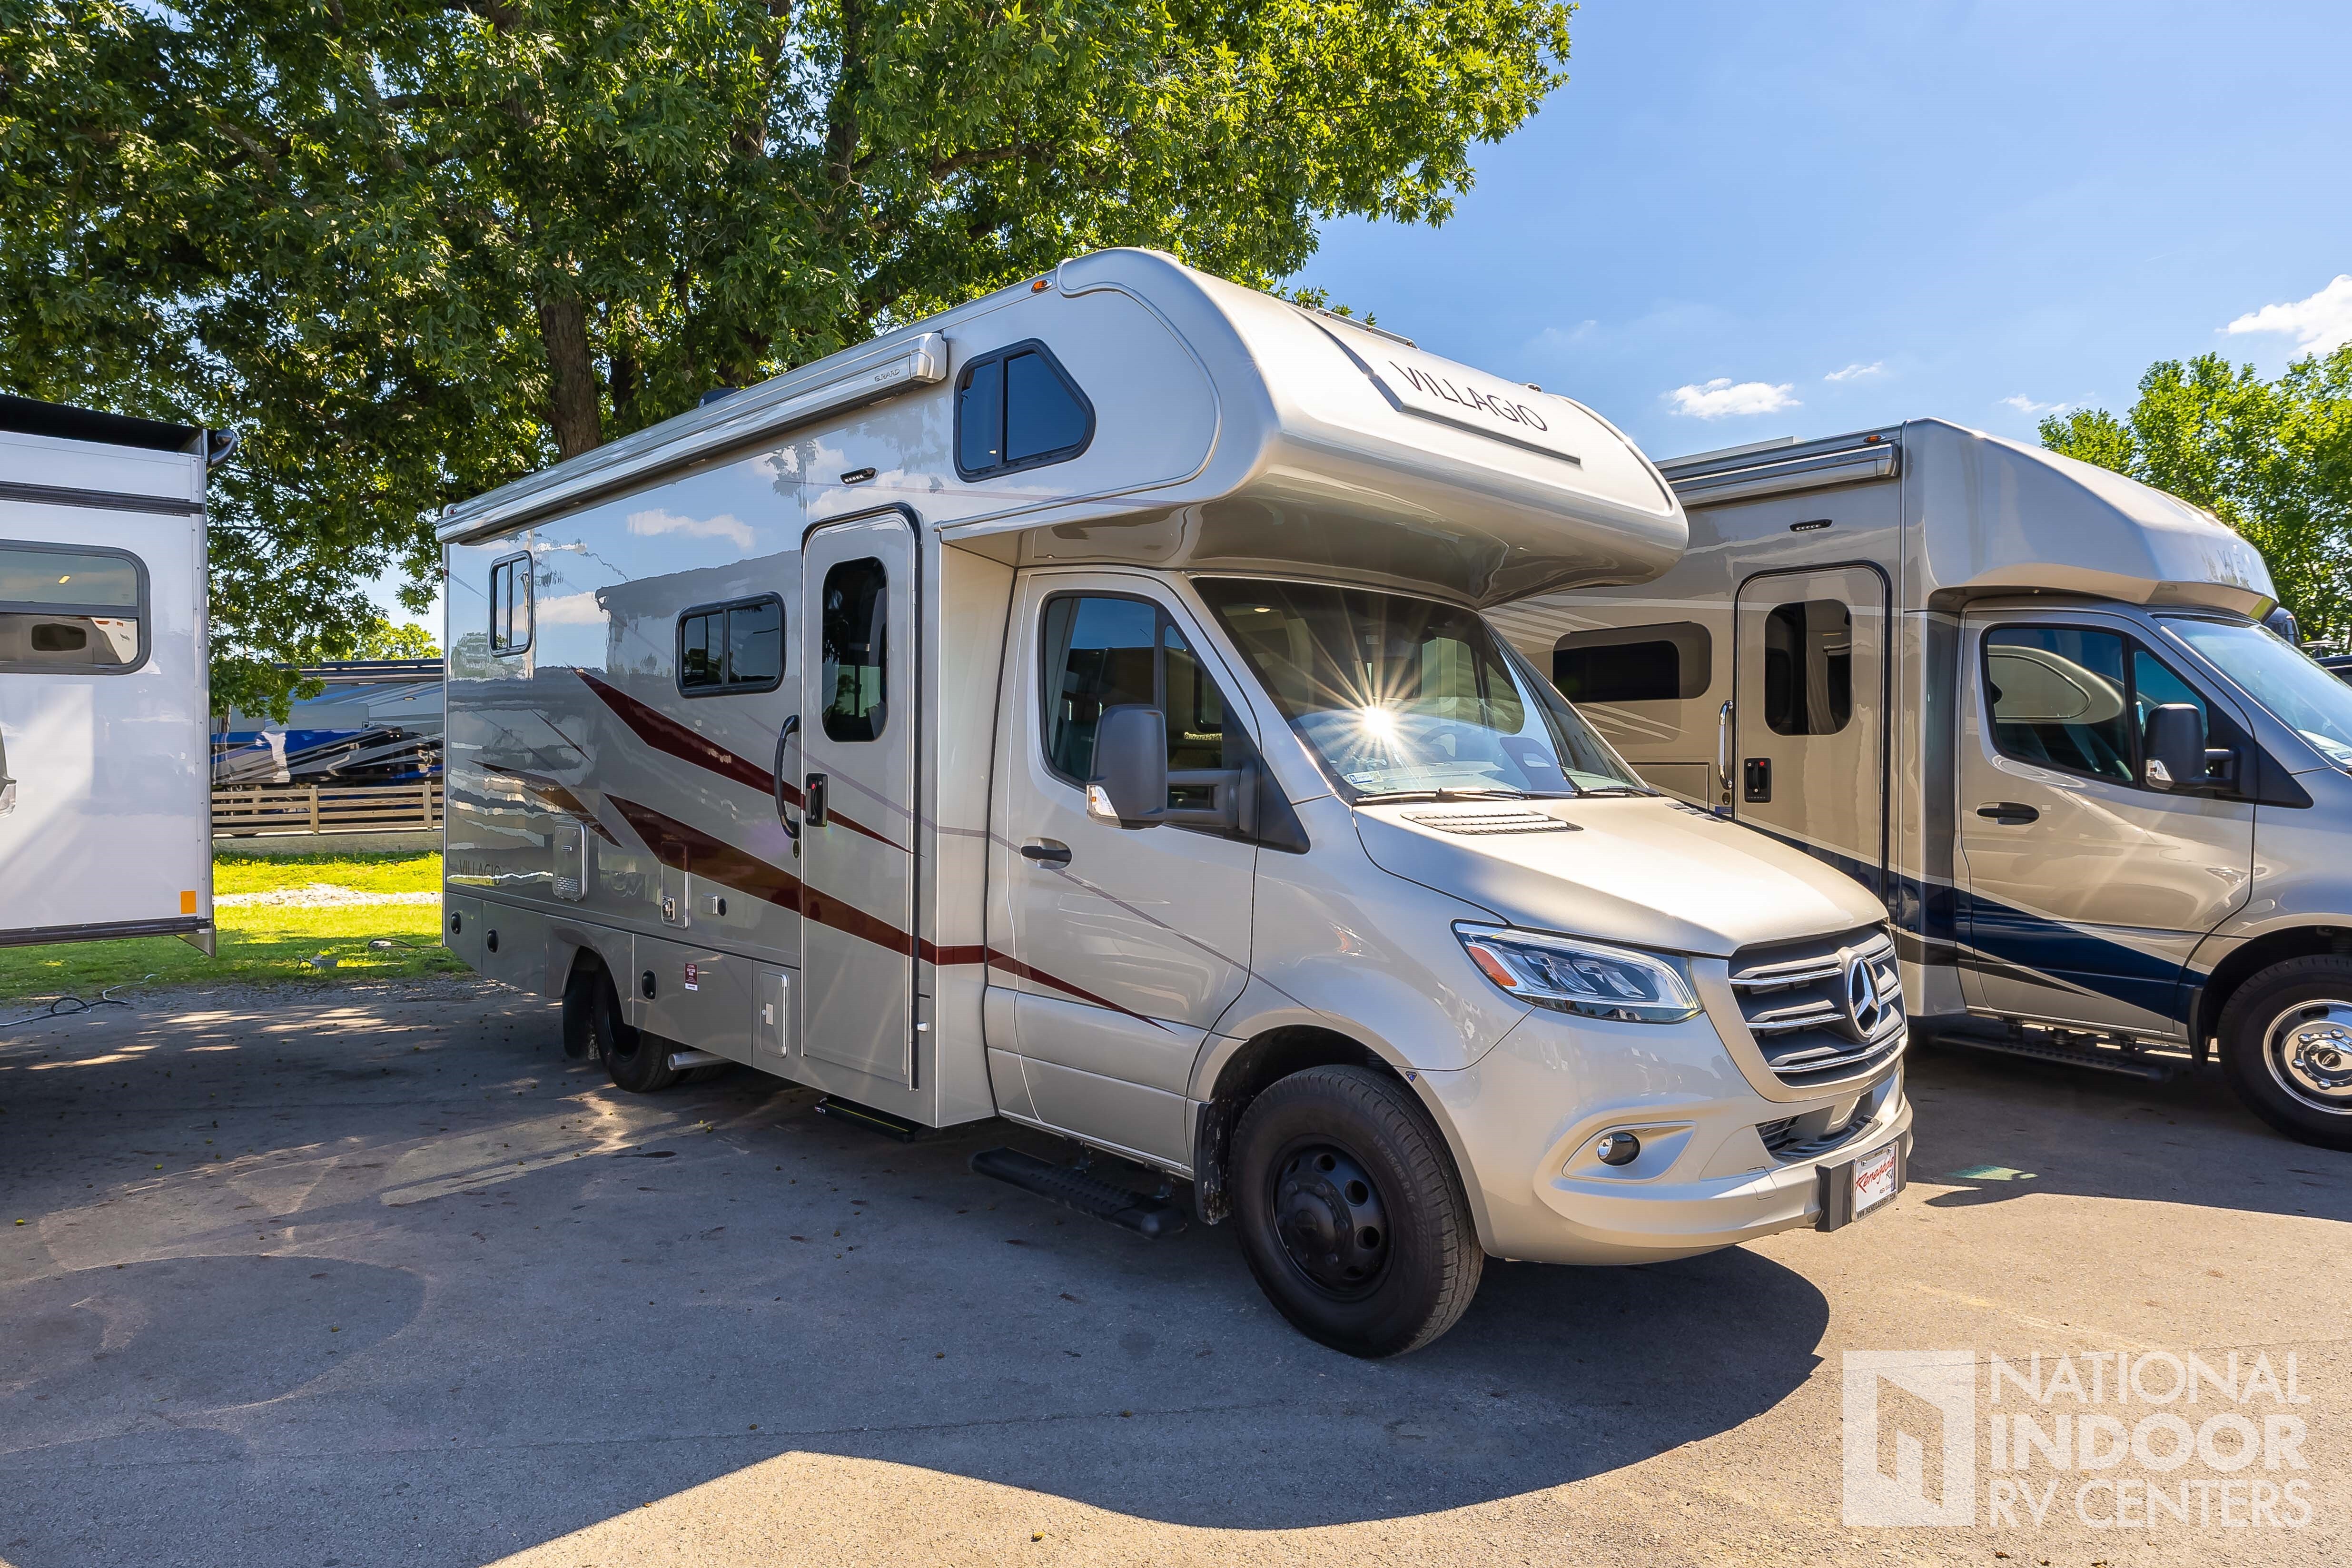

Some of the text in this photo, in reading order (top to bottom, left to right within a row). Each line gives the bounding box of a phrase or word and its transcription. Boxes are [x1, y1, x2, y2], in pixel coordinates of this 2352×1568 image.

[1389, 360, 1547, 431] VILLAGIO
[459, 859, 501, 886] VILLAGIO
[1382, 1148, 1406, 1179] 215/85
[1855, 1154, 1895, 1194] Renegade
[1402, 1181, 1410, 1190] R
[1405, 1192, 1415, 1203] 16
